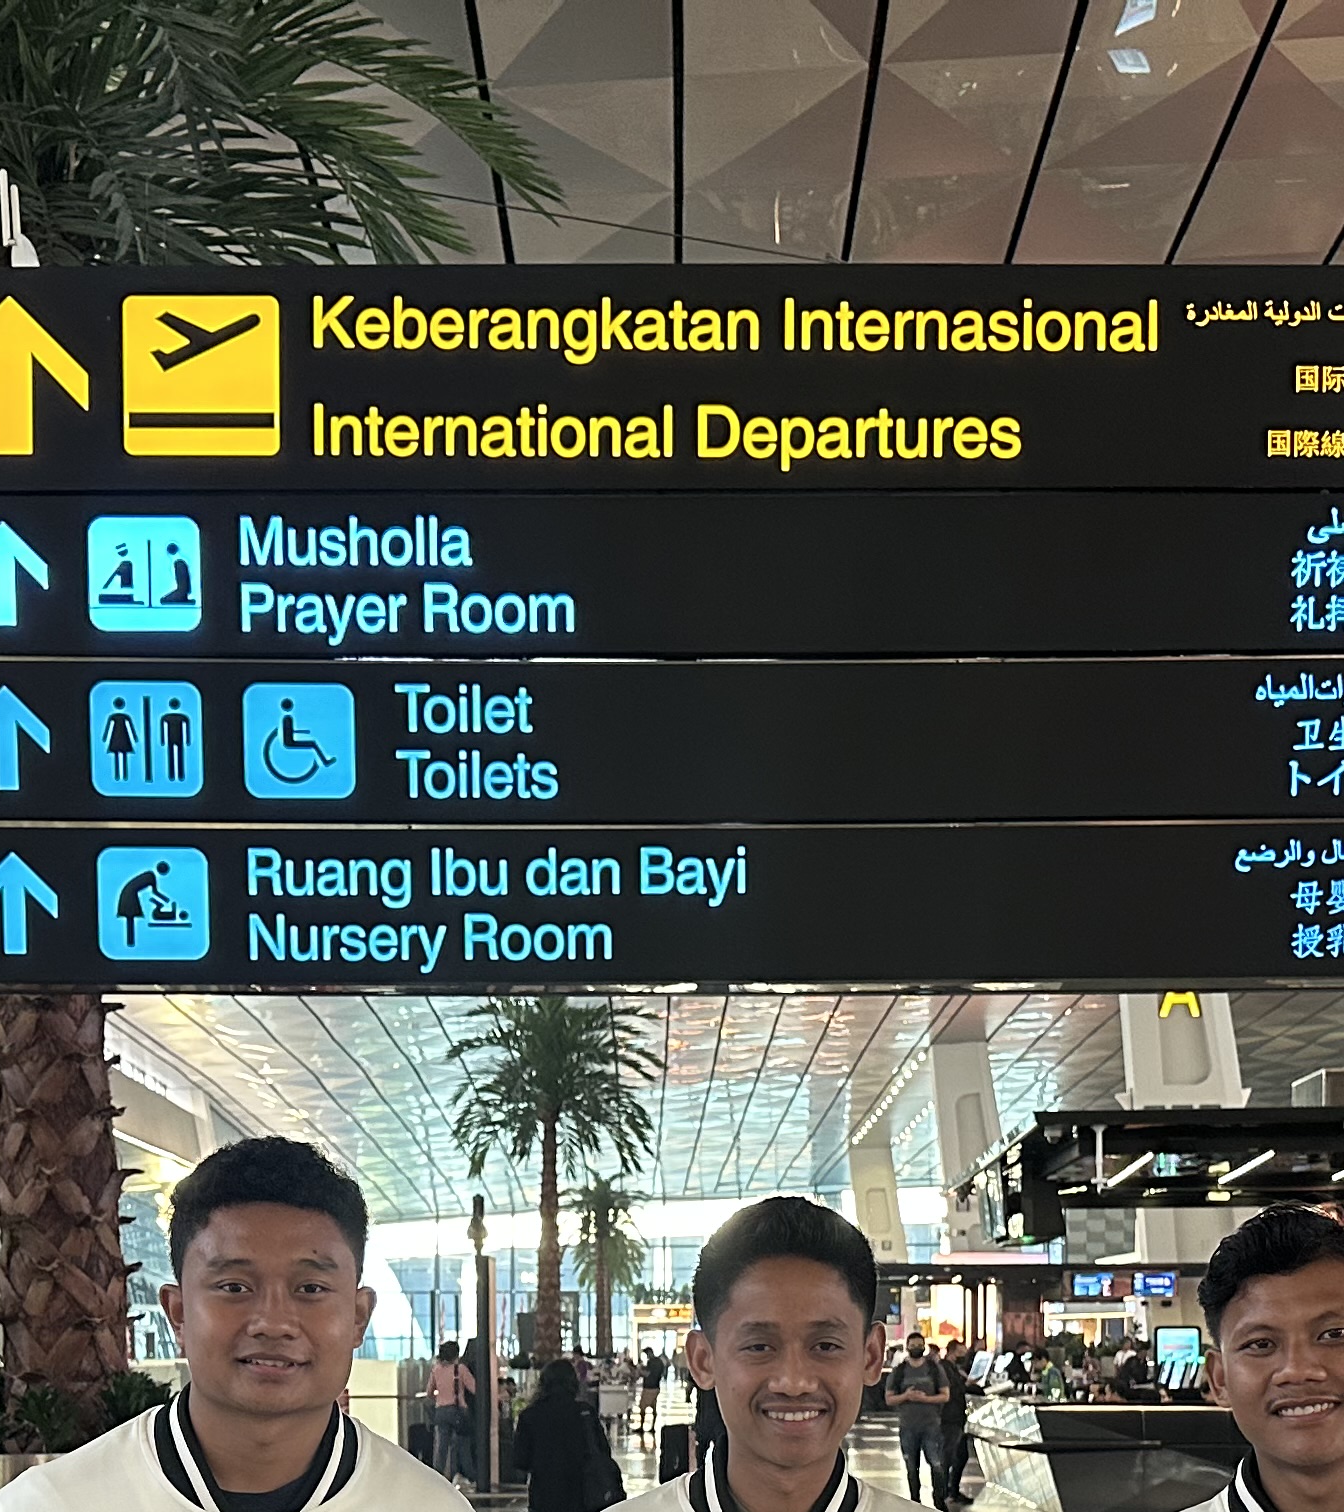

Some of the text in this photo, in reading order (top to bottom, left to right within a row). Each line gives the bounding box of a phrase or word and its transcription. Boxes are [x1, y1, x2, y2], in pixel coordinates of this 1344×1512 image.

[311, 294, 1160, 365] Keberangkatan Internasional
[1185, 299, 1258, 327] المغادرة
[1262, 299, 1321, 328] الدولية
[312, 404, 1023, 472] International Departures
[238, 514, 472, 568] Musholla
[239, 582, 576, 646] Prayer Room
[395, 683, 533, 734] Toilet
[395, 749, 560, 801] Toilets
[247, 845, 748, 908] Ruang Ibu dan Bayi
[1234, 837, 1316, 872] والرضع
[248, 911, 613, 973] Nursery Room
